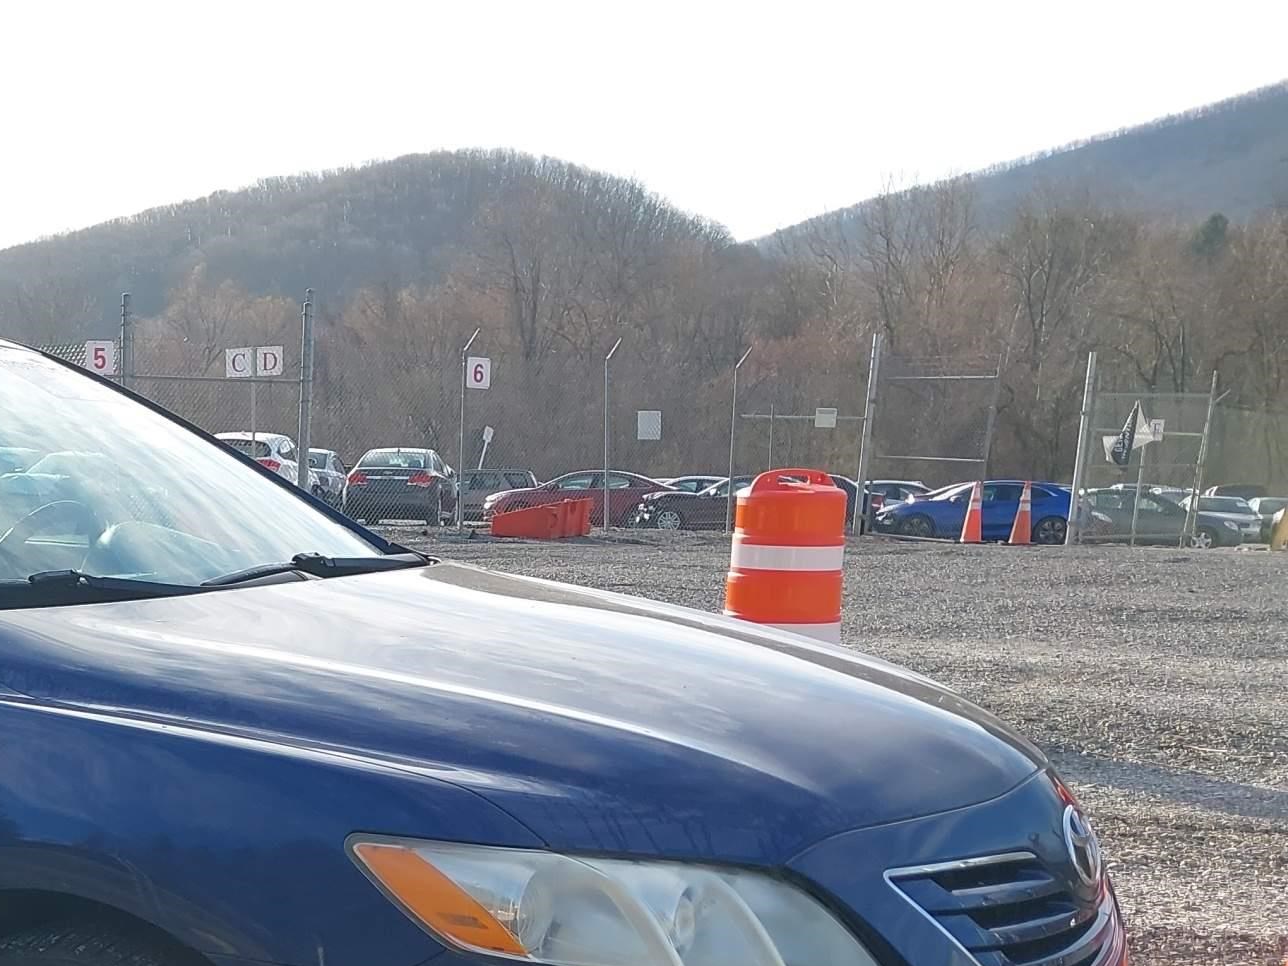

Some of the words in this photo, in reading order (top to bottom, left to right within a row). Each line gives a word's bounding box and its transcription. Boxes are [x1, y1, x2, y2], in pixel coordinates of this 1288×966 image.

[94, 348, 106, 369] 5
[232, 353, 246, 372] C
[263, 352, 278, 371] D
[473, 363, 484, 383] 6
